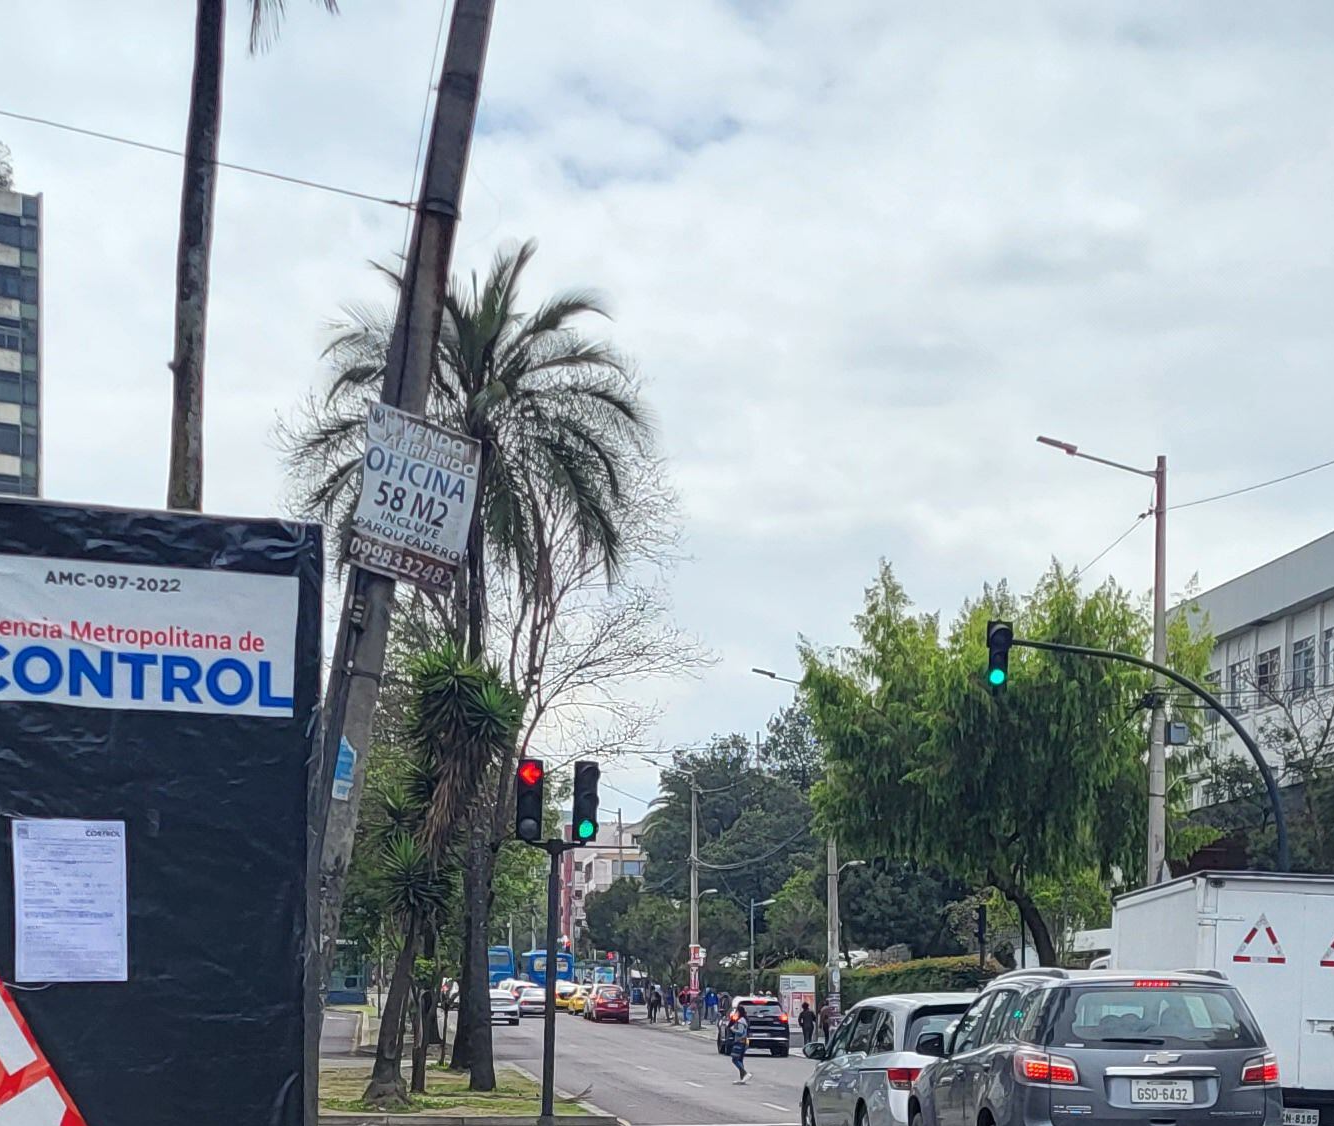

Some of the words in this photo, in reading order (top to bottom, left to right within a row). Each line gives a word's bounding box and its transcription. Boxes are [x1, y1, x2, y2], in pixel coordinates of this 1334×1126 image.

[366, 445, 467, 504] OFICINA
[373, 480, 408, 513] 58
[410, 492, 449, 528] M2
[355, 515, 461, 561] PARQUEADERO
[380, 510, 441, 539] INCLUYE
[44, 570, 182, 593] AMC-097-2022
[70, 620, 232, 649] Metropolitana
[238, 631, 265, 652] de
